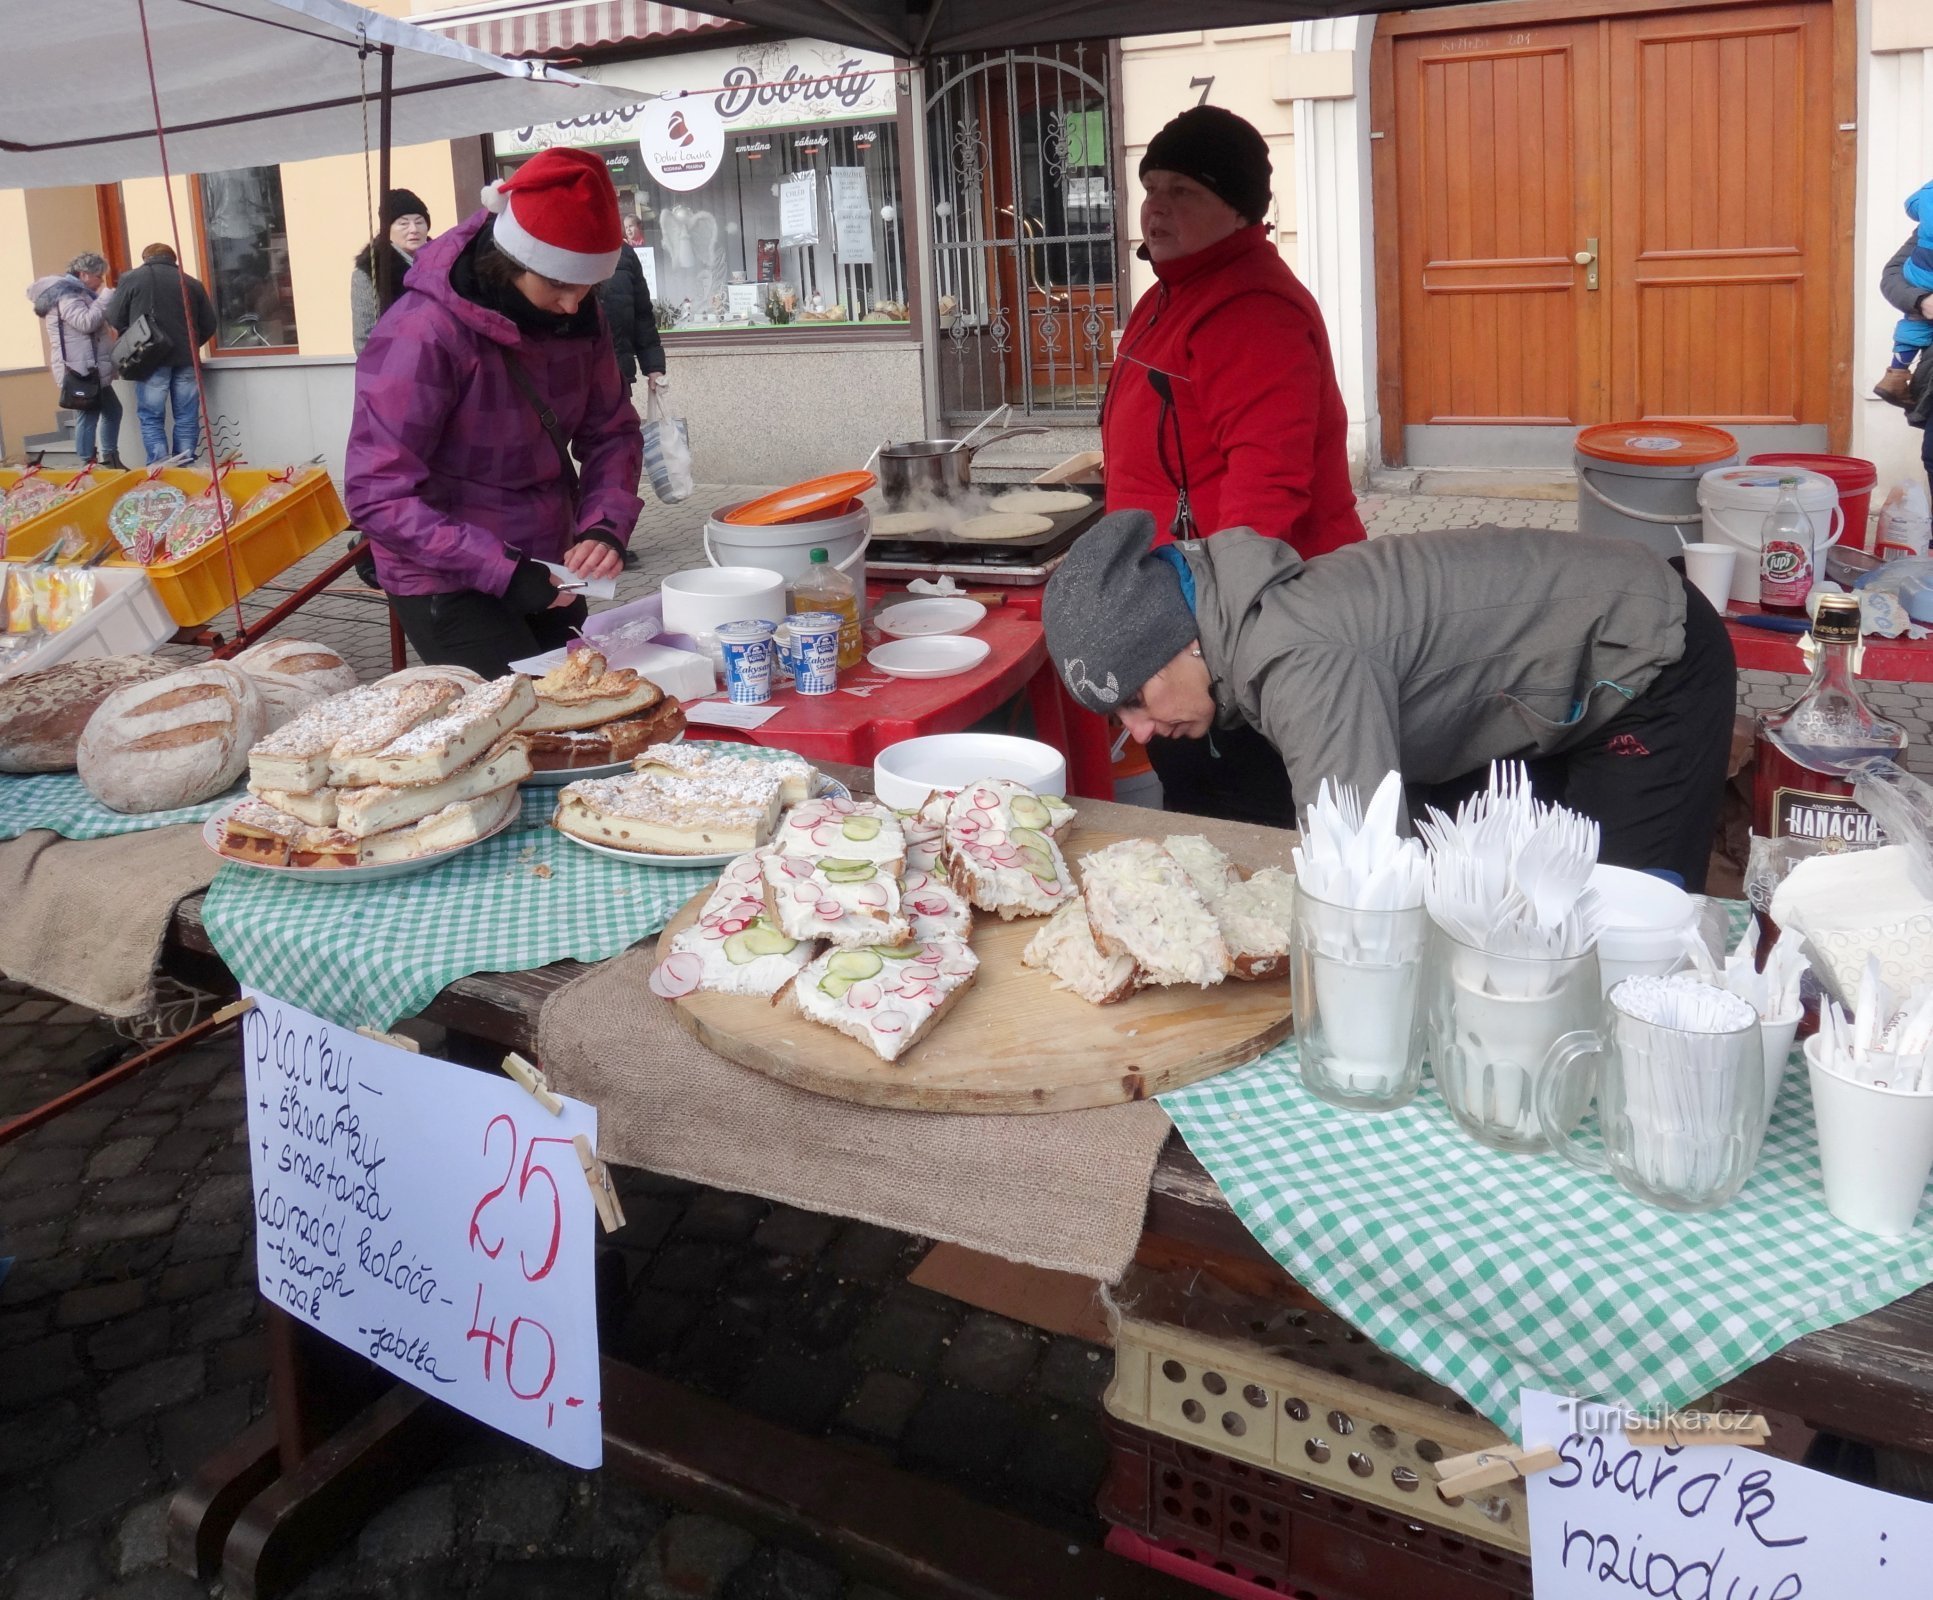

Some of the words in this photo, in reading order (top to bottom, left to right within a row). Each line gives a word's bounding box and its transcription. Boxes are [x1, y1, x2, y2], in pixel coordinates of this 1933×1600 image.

[714, 59, 876, 118] Dobroty
[1189, 75, 1215, 107] 7
[735, 142, 771, 153] zmrzlina
[794, 134, 829, 148] zákusky
[852, 130, 877, 142] dorty
[605, 155, 630, 166] saláty
[470, 1114, 574, 1282] 25
[258, 1180, 346, 1258] domácí
[278, 1278, 321, 1320] mak
